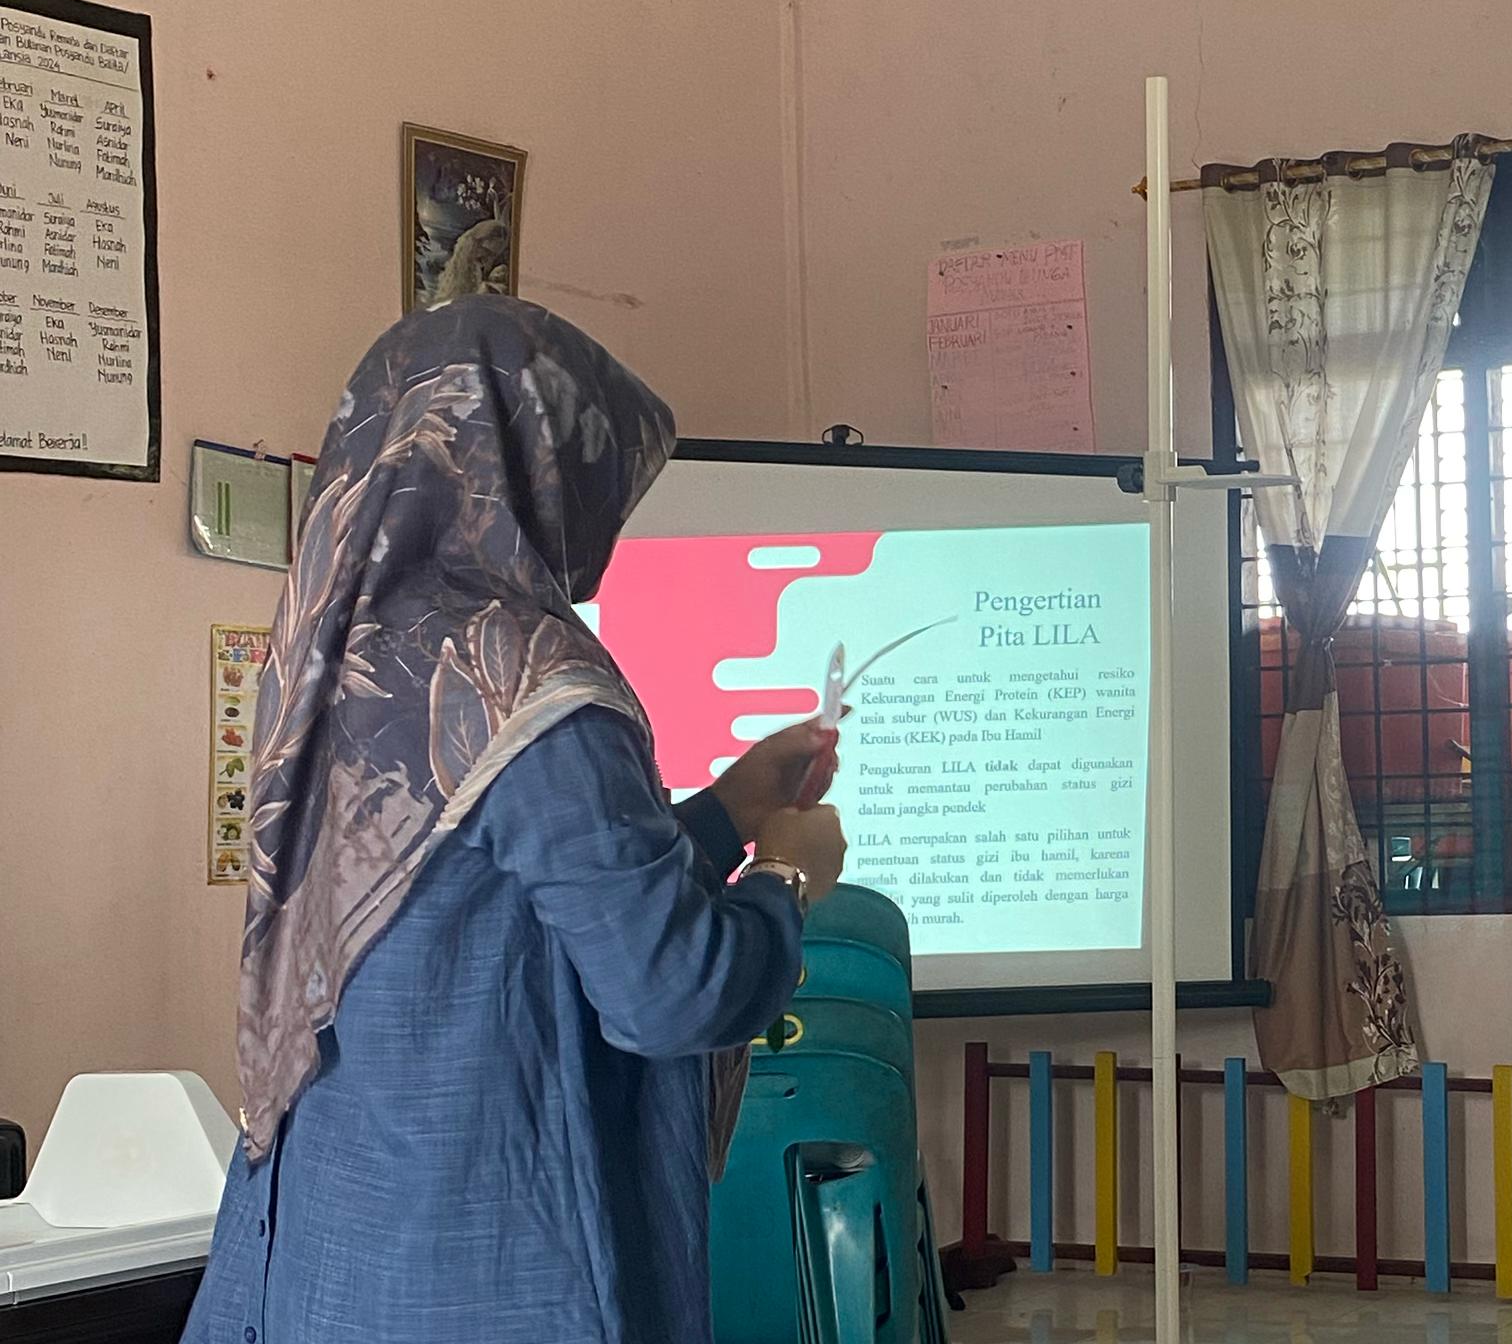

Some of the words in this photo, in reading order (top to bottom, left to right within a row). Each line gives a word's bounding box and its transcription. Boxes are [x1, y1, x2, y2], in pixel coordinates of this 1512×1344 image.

[6, 132, 29, 148] Neni
[93, 235, 126, 253] Hasnah
[97, 256, 119, 270] Neni
[33, 294, 76, 311] November
[46, 316, 64, 329] Eka
[929, 315, 979, 334] JANUARI
[40, 331, 77, 347] Hasnah
[929, 331, 986, 352] FEBRUARI
[47, 347, 71, 362] Neni
[975, 588, 1102, 615] Pengertian
[979, 626, 1024, 647] Pita
[1032, 624, 1100, 645] LILA
[861, 675, 895, 686] Suatu
[914, 675, 938, 684] cara
[957, 672, 991, 683] untuk
[1009, 670, 1078, 683] mengetahui
[1098, 668, 1135, 679] resiko
[861, 692, 934, 706] Kekurangan
[945, 690, 984, 703] Energi
[995, 690, 1038, 701] Protein
[1048, 687, 1086, 701] (KEP)
[1096, 688, 1135, 698] wanita
[861, 715, 884, 724] usia
[892, 712, 926, 723] subur
[934, 711, 977, 723] (WUS)
[984, 710, 1006, 721] dan
[1015, 708, 1088, 722] Kekurangan
[1096, 707, 1135, 720] Energi
[860, 734, 901, 745] Kronis
[905, 732, 945, 745] (KEK)
[950, 732, 978, 746] pada
[981, 730, 1000, 741] Ibu
[1005, 729, 1042, 741] Hamil
[860, 764, 931, 778] Pengukuran
[942, 761, 975, 773] LILA
[985, 761, 1018, 772] tidak
[1028, 760, 1061, 772] dapat
[1071, 758, 1133, 771] digunakan
[859, 783, 893, 795] untuk
[908, 783, 970, 794] memantau
[984, 780, 1048, 795] perubahan
[1062, 780, 1096, 790] status
[1111, 778, 1132, 791] gizi
[858, 804, 895, 815] dalam
[898, 802, 939, 817] jangka
[942, 801, 986, 817] pendek
[858, 835, 891, 846] LILA
[900, 833, 967, 847] merupakan
[975, 831, 1006, 843] salah
[1015, 831, 1039, 841] satu
[1047, 829, 1089, 844] pilihan
[1098, 828, 1131, 839] untuk
[858, 856, 919, 869] penentuan
[930, 853, 965, 864] status
[976, 852, 999, 866] gizi
[1011, 851, 1030, 862] ibu
[1041, 849, 1078, 862] hamil,
[1091, 848, 1130, 860] karena
[857, 874, 898, 886] mudah
[909, 872, 969, 884] dilakukan
[981, 871, 1002, 882] dan
[1014, 869, 1044, 881] tidak
[1056, 868, 1129, 880] memerlukan
[911, 895, 940, 906] yang
[947, 892, 974, 903] sulit
[981, 891, 1037, 905] diperoleh
[1045, 889, 1088, 903] dengan
[1095, 888, 1128, 901] harga
[922, 914, 964, 924] murah.
